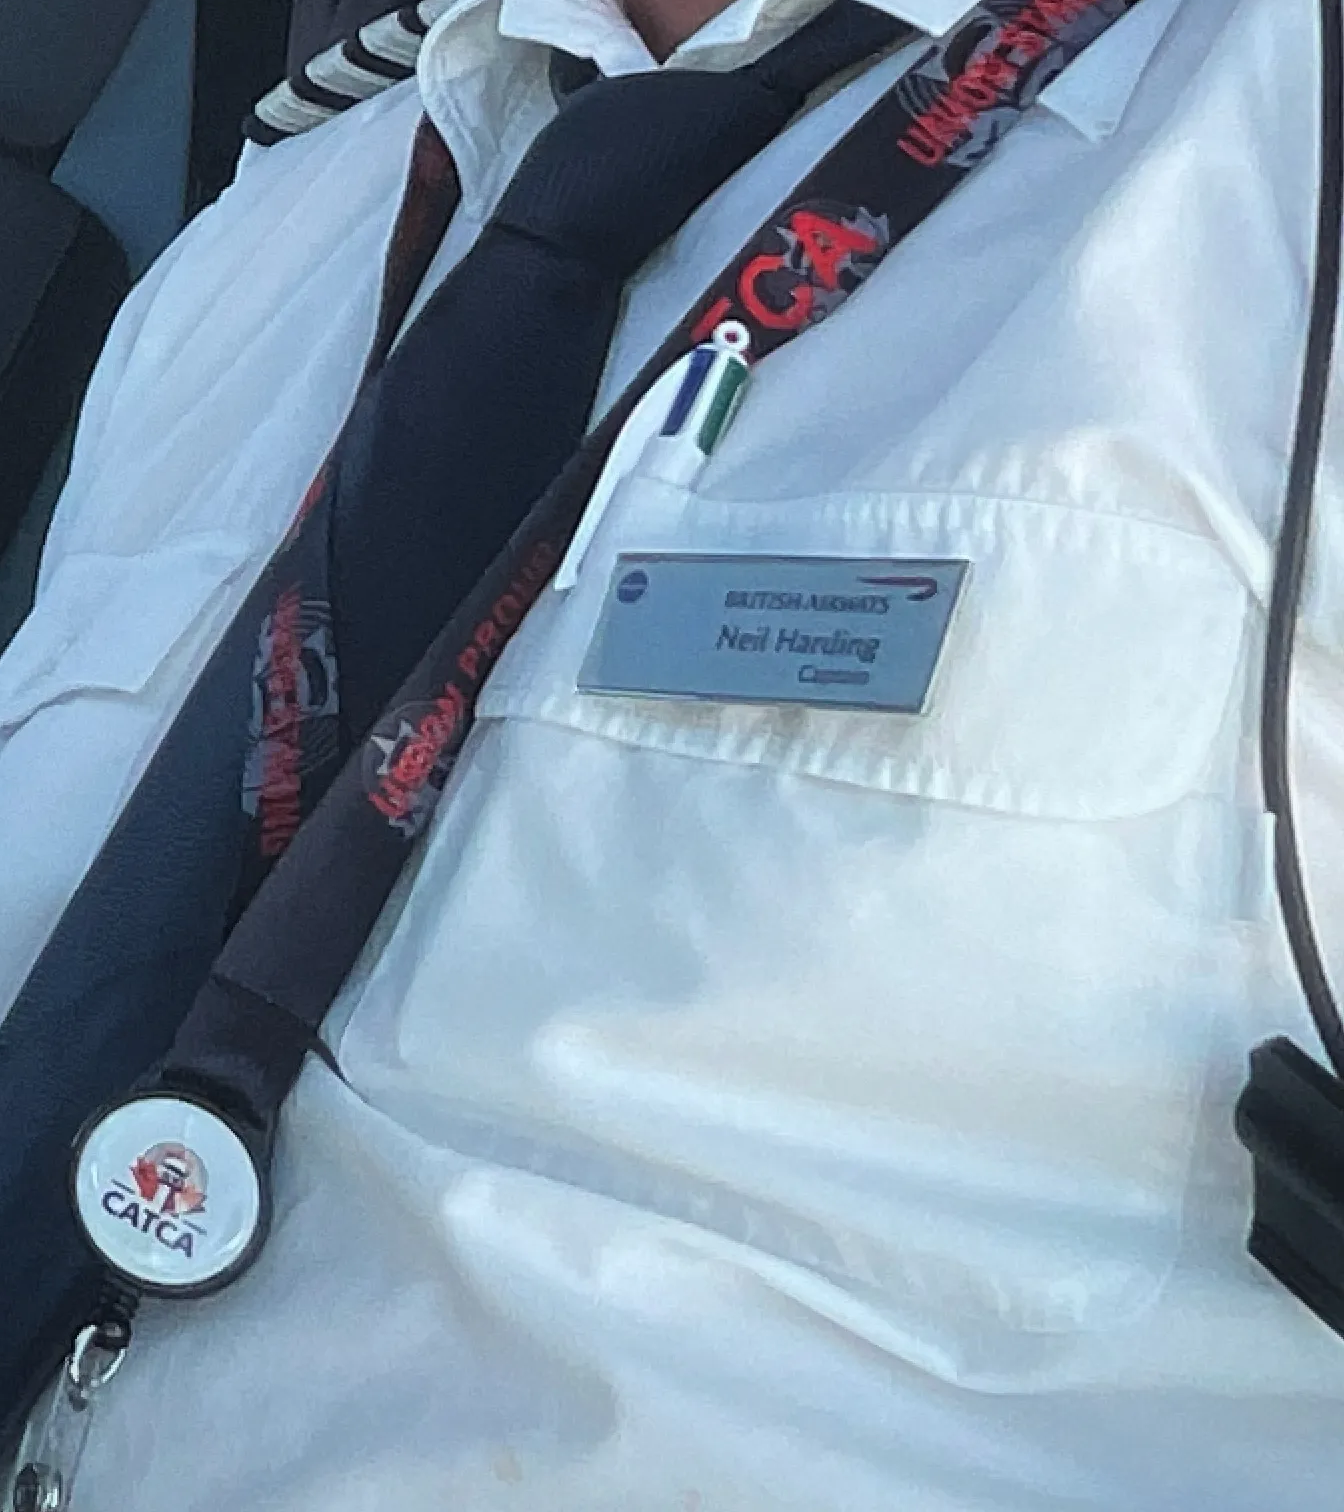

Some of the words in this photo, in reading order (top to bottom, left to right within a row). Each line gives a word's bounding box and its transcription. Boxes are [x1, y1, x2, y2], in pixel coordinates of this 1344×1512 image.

[716, 624, 770, 652] Neil
[775, 628, 881, 663] Harding
[100, 1189, 195, 1258] CATCA
